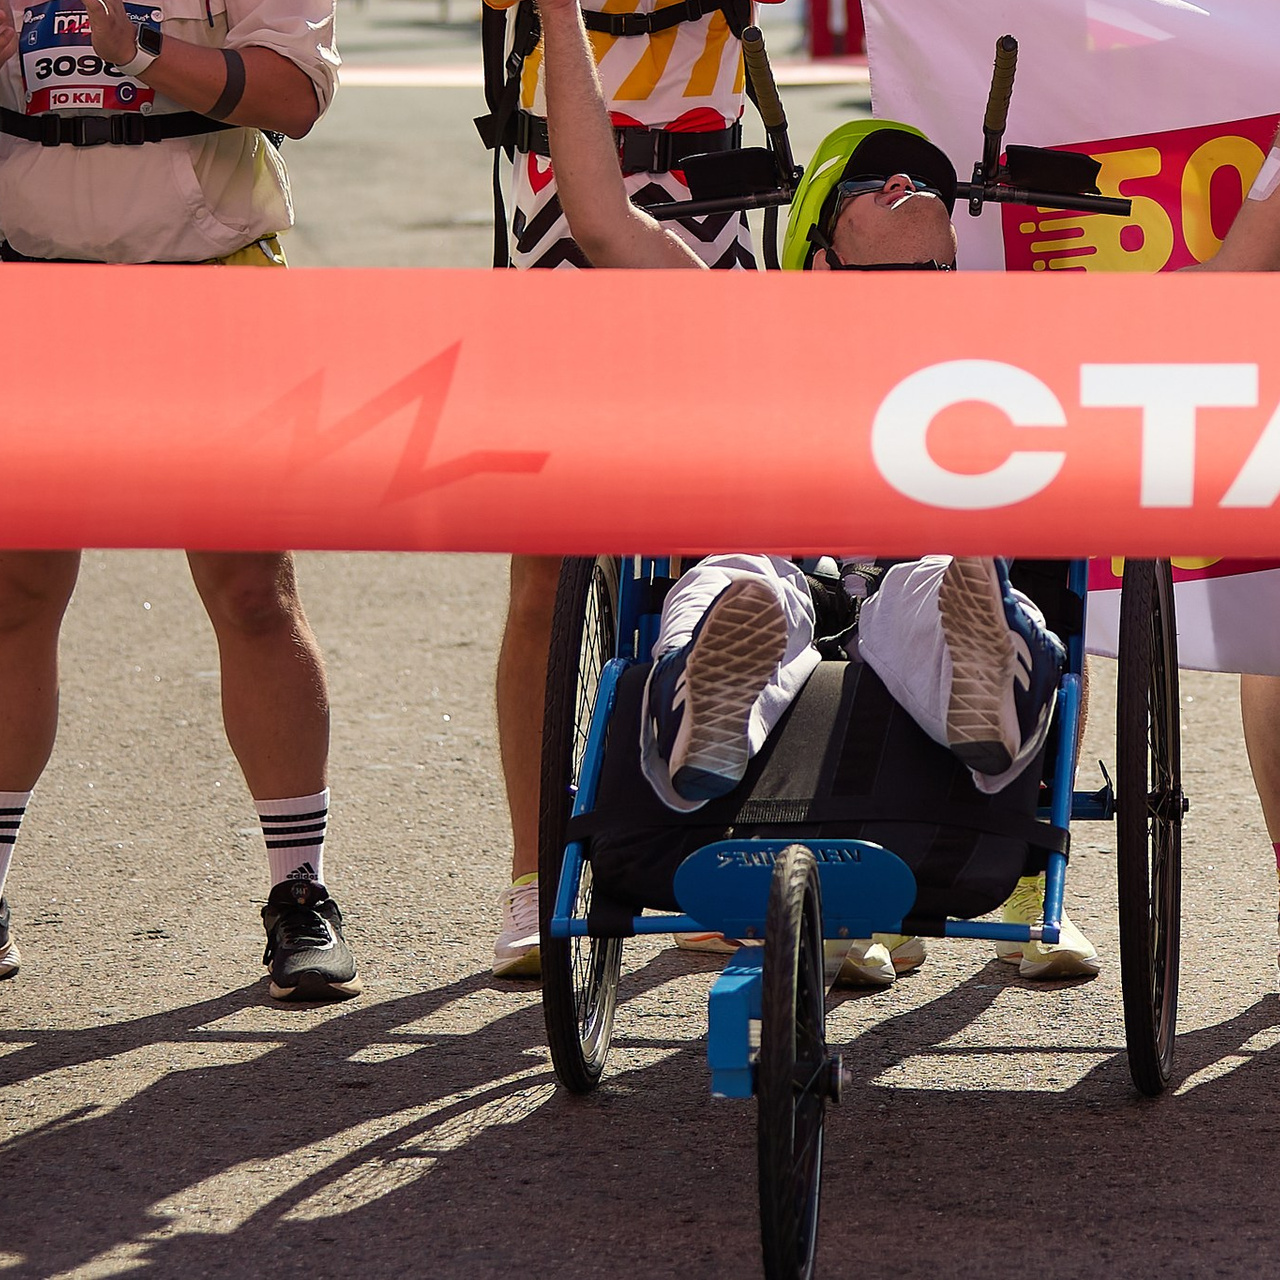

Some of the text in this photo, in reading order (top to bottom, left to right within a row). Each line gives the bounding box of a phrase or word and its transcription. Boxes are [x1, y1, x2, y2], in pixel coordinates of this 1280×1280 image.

[52, 86, 133, 105] 10 KM C
